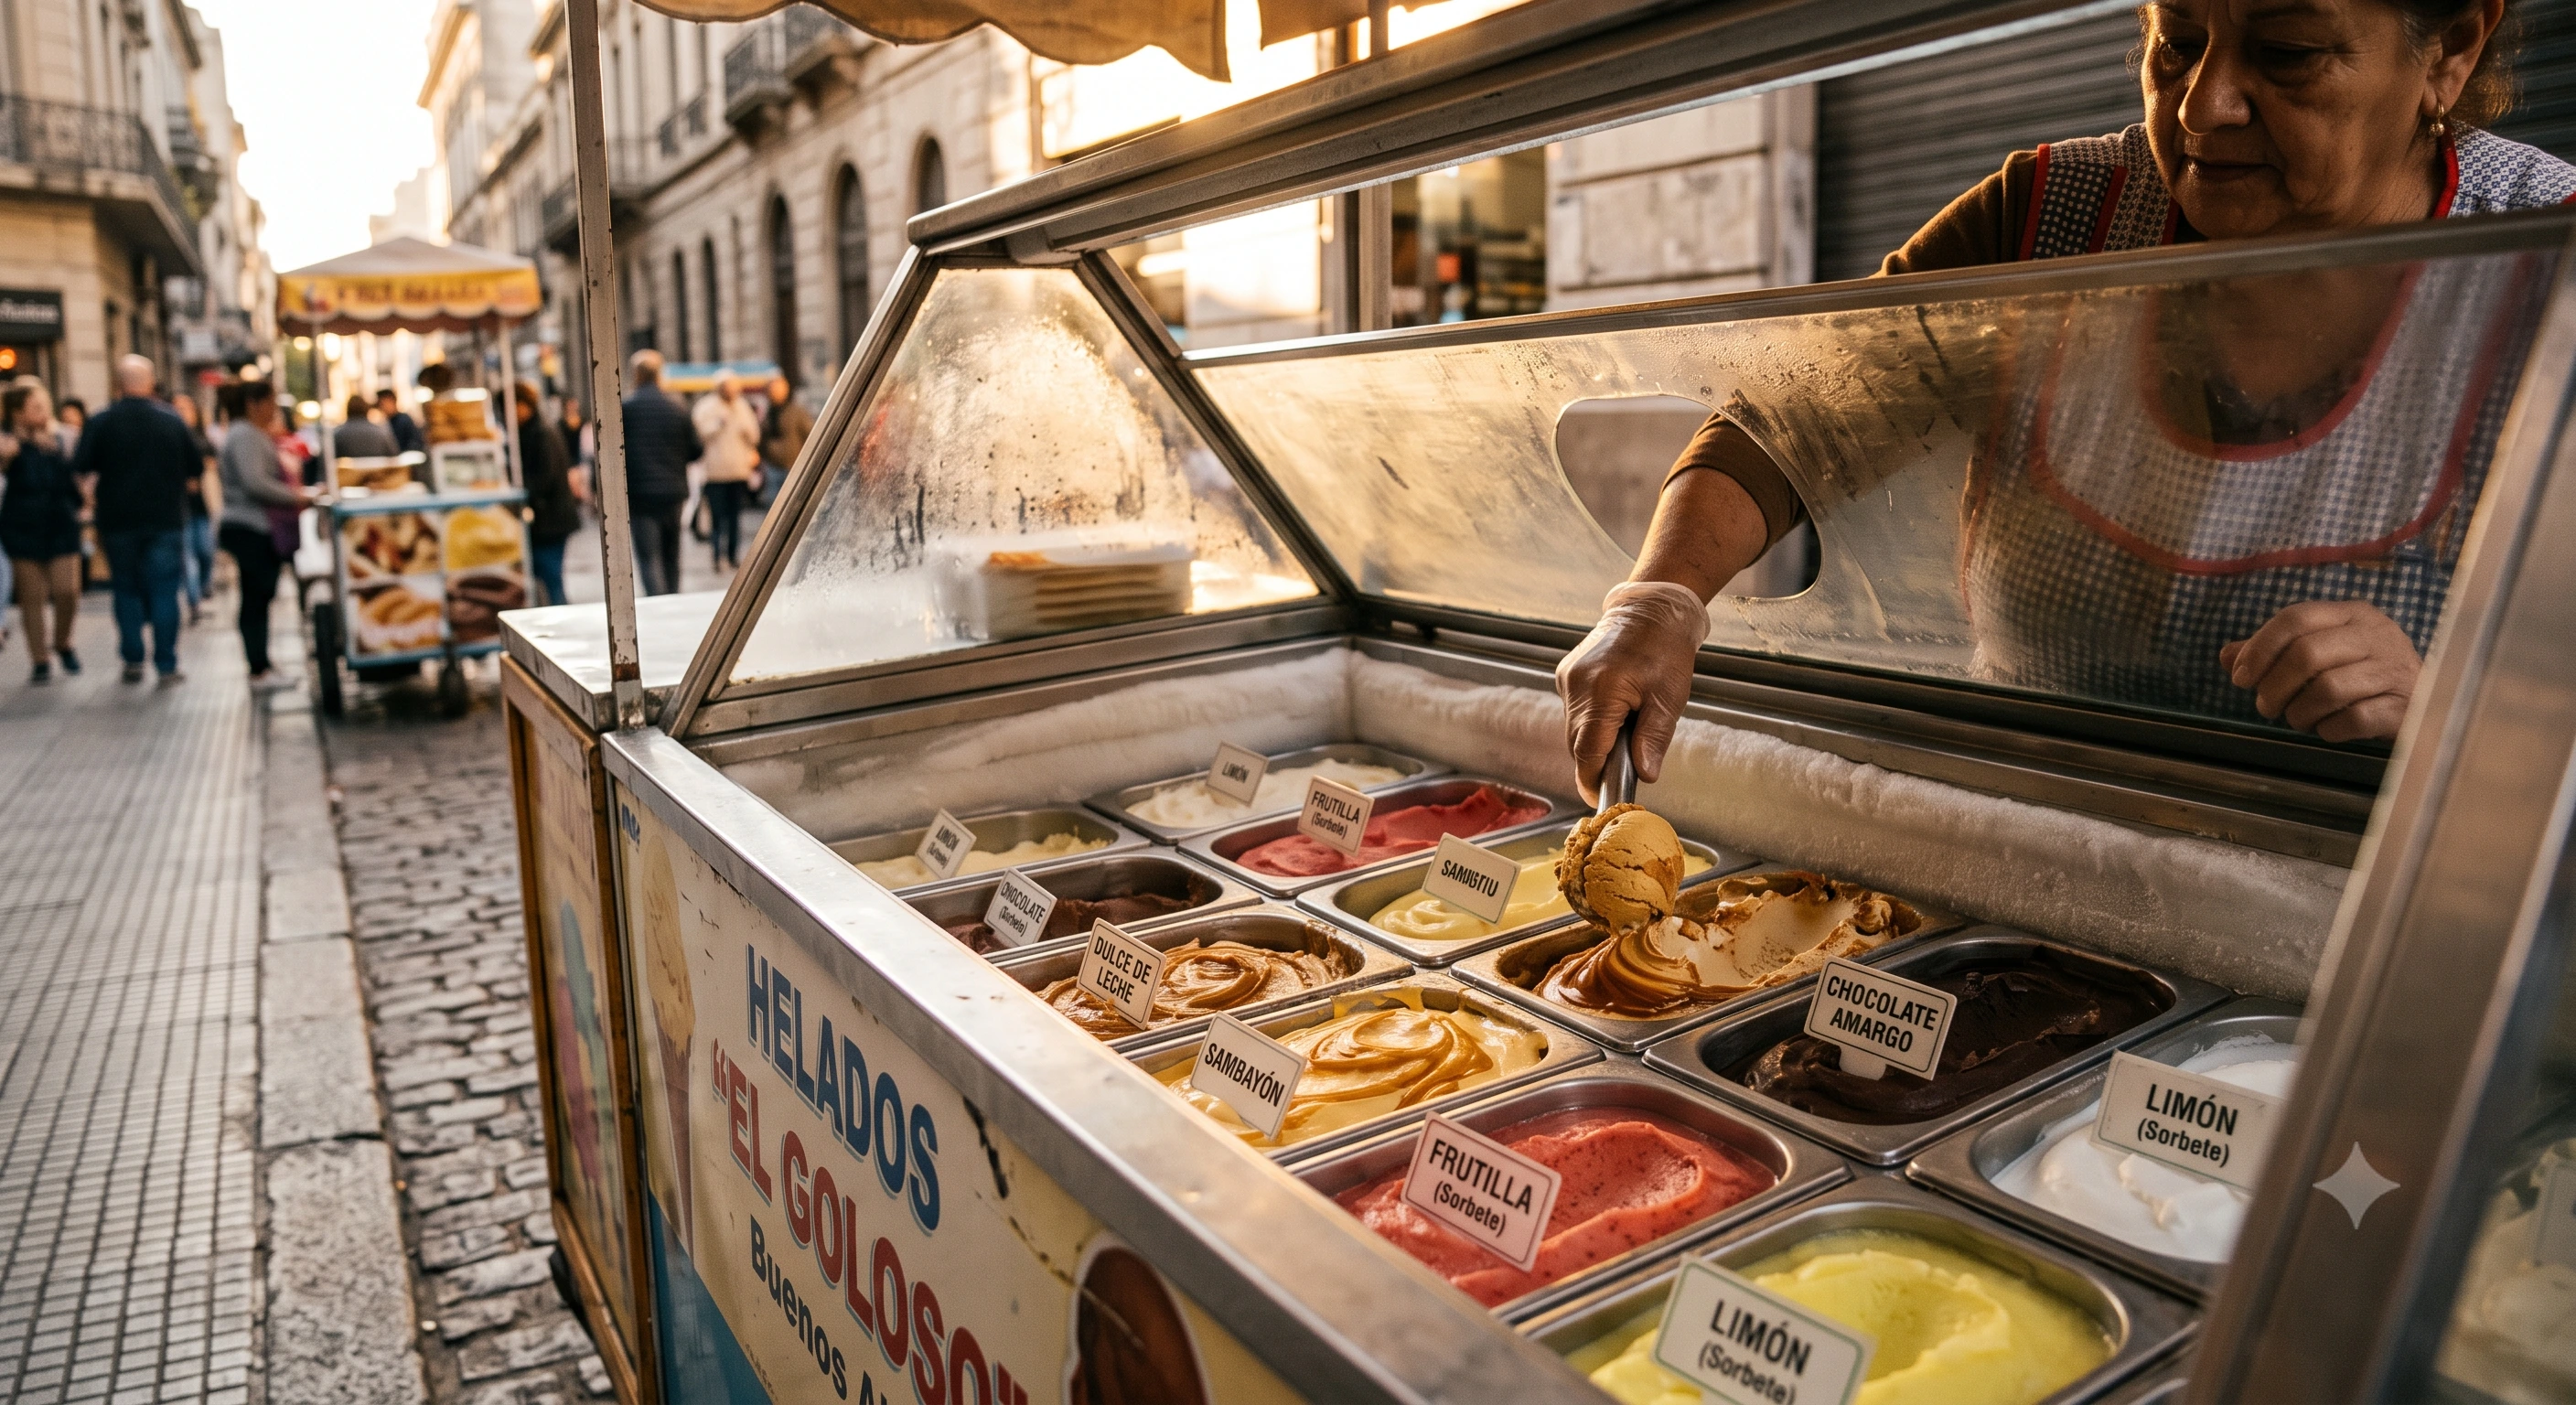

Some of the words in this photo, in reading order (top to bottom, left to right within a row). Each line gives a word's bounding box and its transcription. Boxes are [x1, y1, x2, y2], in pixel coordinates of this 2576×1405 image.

[1311, 790, 1361, 825] FRUTILLA
[1093, 936, 1133, 975] DULCE
[1132, 959, 1153, 985] DE
[1096, 966, 1135, 1004] LECHE
[1827, 976, 1938, 1031] CHOCOLATE
[1830, 1007, 1913, 1053] AMARGO
[746, 943, 940, 1236] HELADOS
[1204, 1043, 1285, 1108] SAMBAYÓN
[2146, 1083, 2239, 1137] LIMÓN
[2137, 1118, 2230, 1169] (Sorbete)
[1429, 1138, 1533, 1216] FRUTILLA
[1433, 1181, 1507, 1238] (Sorbete)
[751, 1214, 847, 1400] Buenos
[1711, 1298, 1812, 1377] LIMÓN
[1699, 1340, 1797, 1405] (Sorbete)
